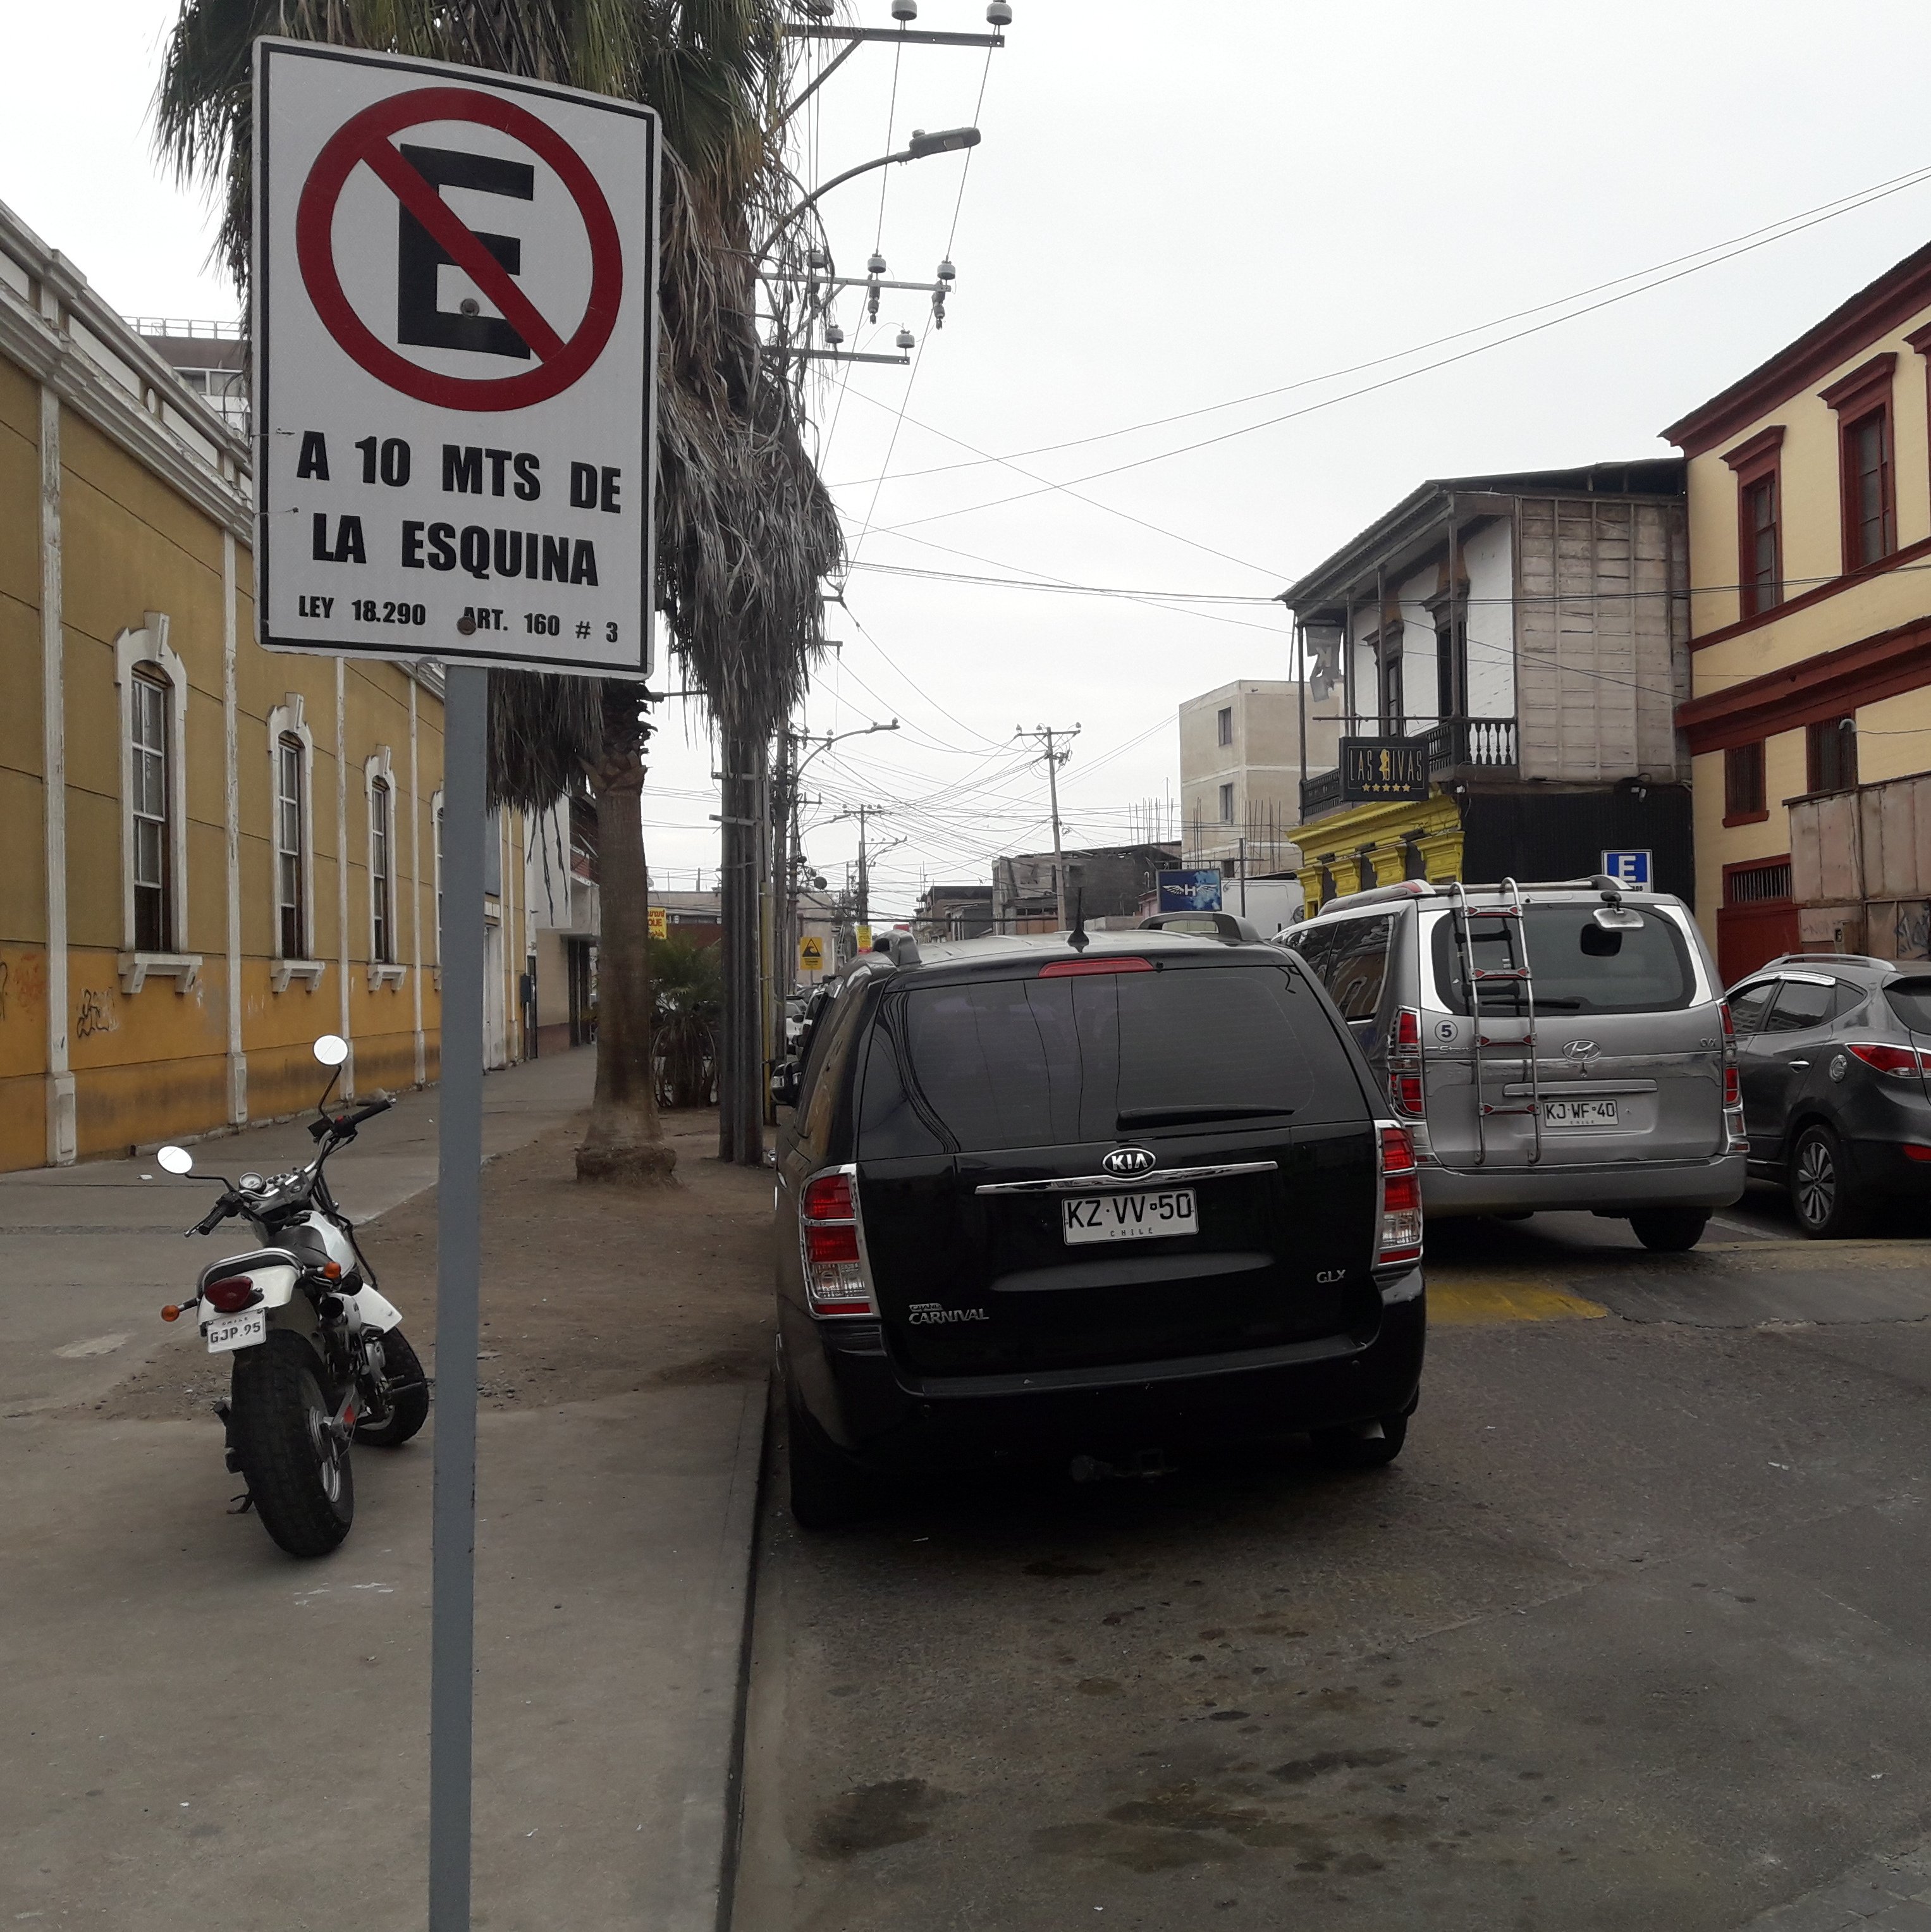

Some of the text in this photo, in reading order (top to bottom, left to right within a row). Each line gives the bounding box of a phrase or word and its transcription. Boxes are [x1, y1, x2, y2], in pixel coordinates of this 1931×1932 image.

[297, 431, 622, 514] A 10 MTS DE
[313, 513, 599, 587] LA ESQUINA
[298, 595, 334, 618] LEY
[351, 600, 426, 625] 18.290
[524, 613, 560, 636] 160
[575, 622, 591, 640] #
[606, 622, 618, 643] 3
[1350, 750, 1372, 781] LAS
[1619, 855, 1636, 881] E
[1184, 883, 1196, 897] H
[1441, 1024, 1452, 1038] 5
[1111, 1153, 1148, 1171] KIA
[1110, 1227, 1153, 1237] CHILE
[1316, 1269, 1346, 1284] GLX
[909, 1308, 990, 1324] CARNIVAL
